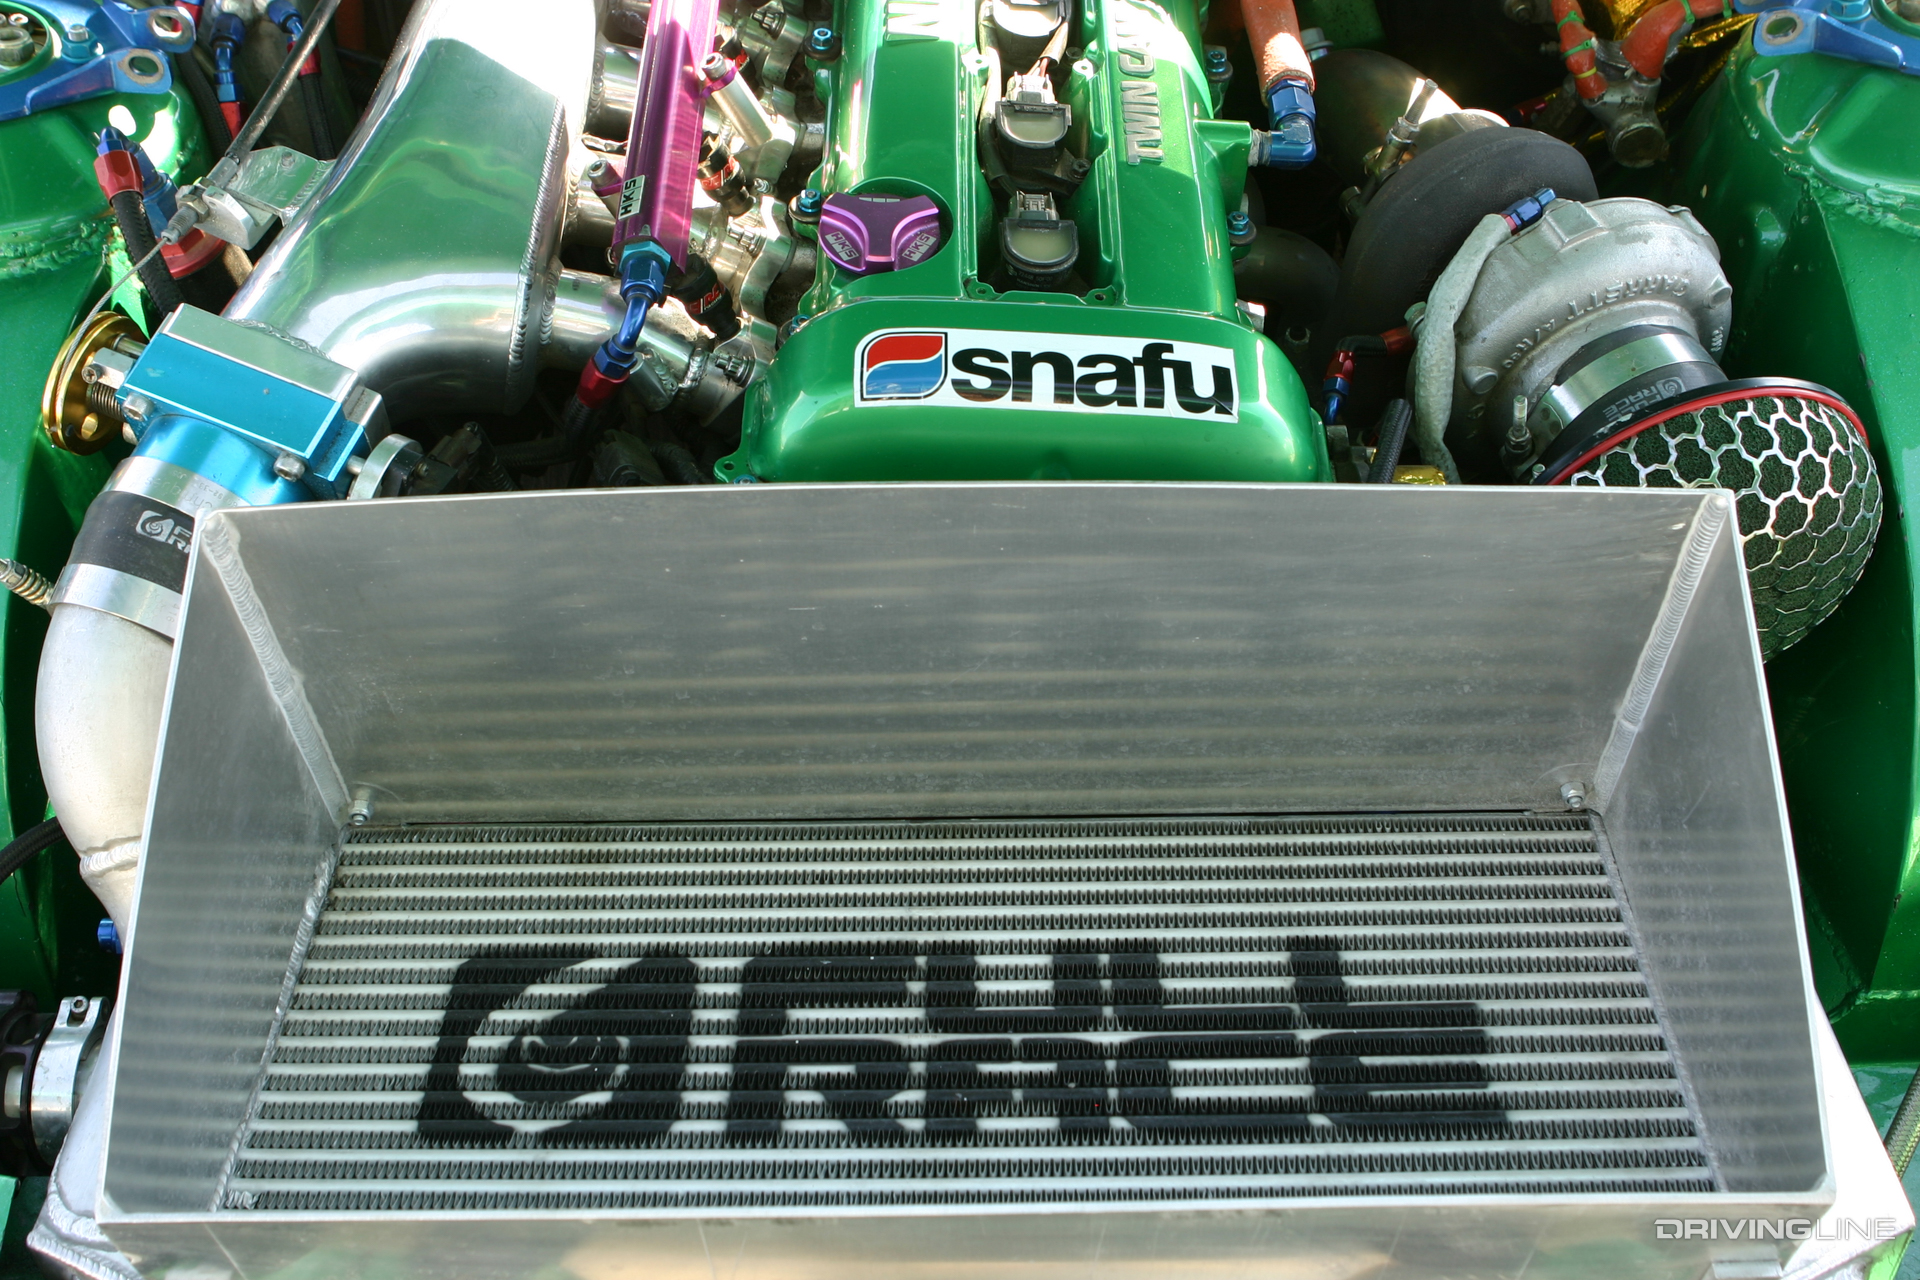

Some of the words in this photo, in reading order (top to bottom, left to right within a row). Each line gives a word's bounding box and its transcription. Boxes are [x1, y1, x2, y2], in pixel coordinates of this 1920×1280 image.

[1120, 81, 1164, 165] TWIN
[620, 178, 637, 216] HKS
[830, 231, 858, 259] HKS
[902, 233, 931, 260] HKS
[1567, 275, 1691, 321] GARRETT
[951, 343, 1234, 414] snafu
[1602, 386, 1658, 418] RACE
[737, 935, 1481, 1035] FULL
[726, 1030, 1510, 1147] RACE
